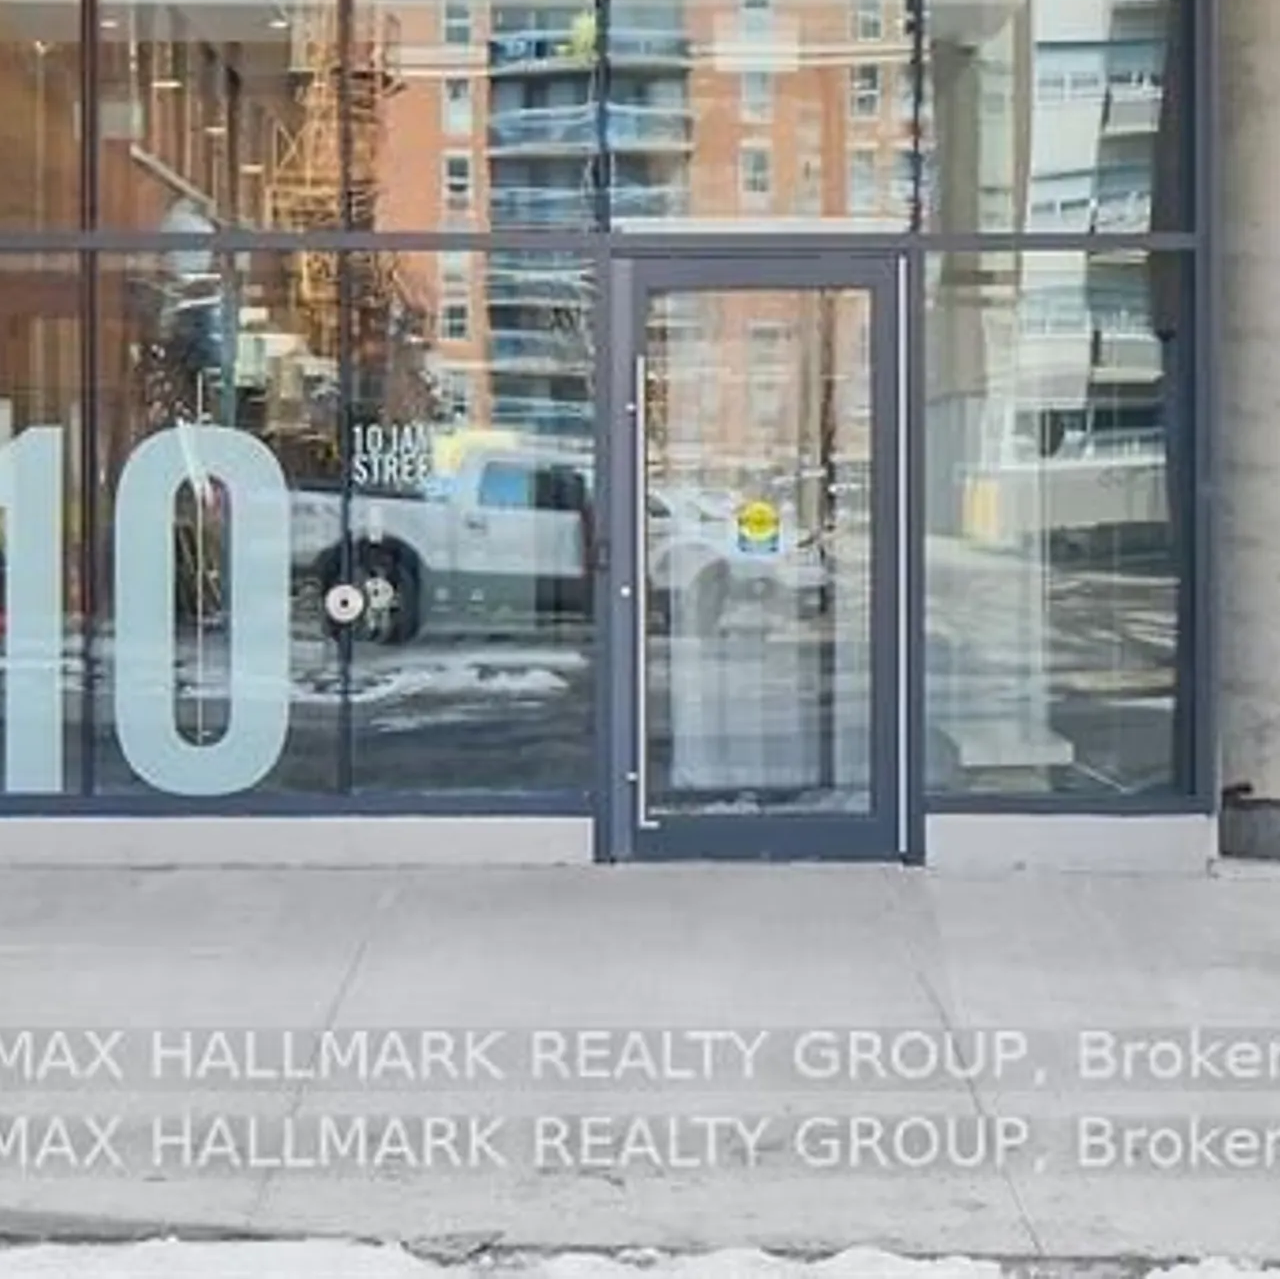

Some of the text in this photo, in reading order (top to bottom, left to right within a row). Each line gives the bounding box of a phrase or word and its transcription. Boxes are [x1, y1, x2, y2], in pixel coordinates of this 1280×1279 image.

[352, 423, 438, 454] 10 JAM
[351, 452, 435, 485] STREE
